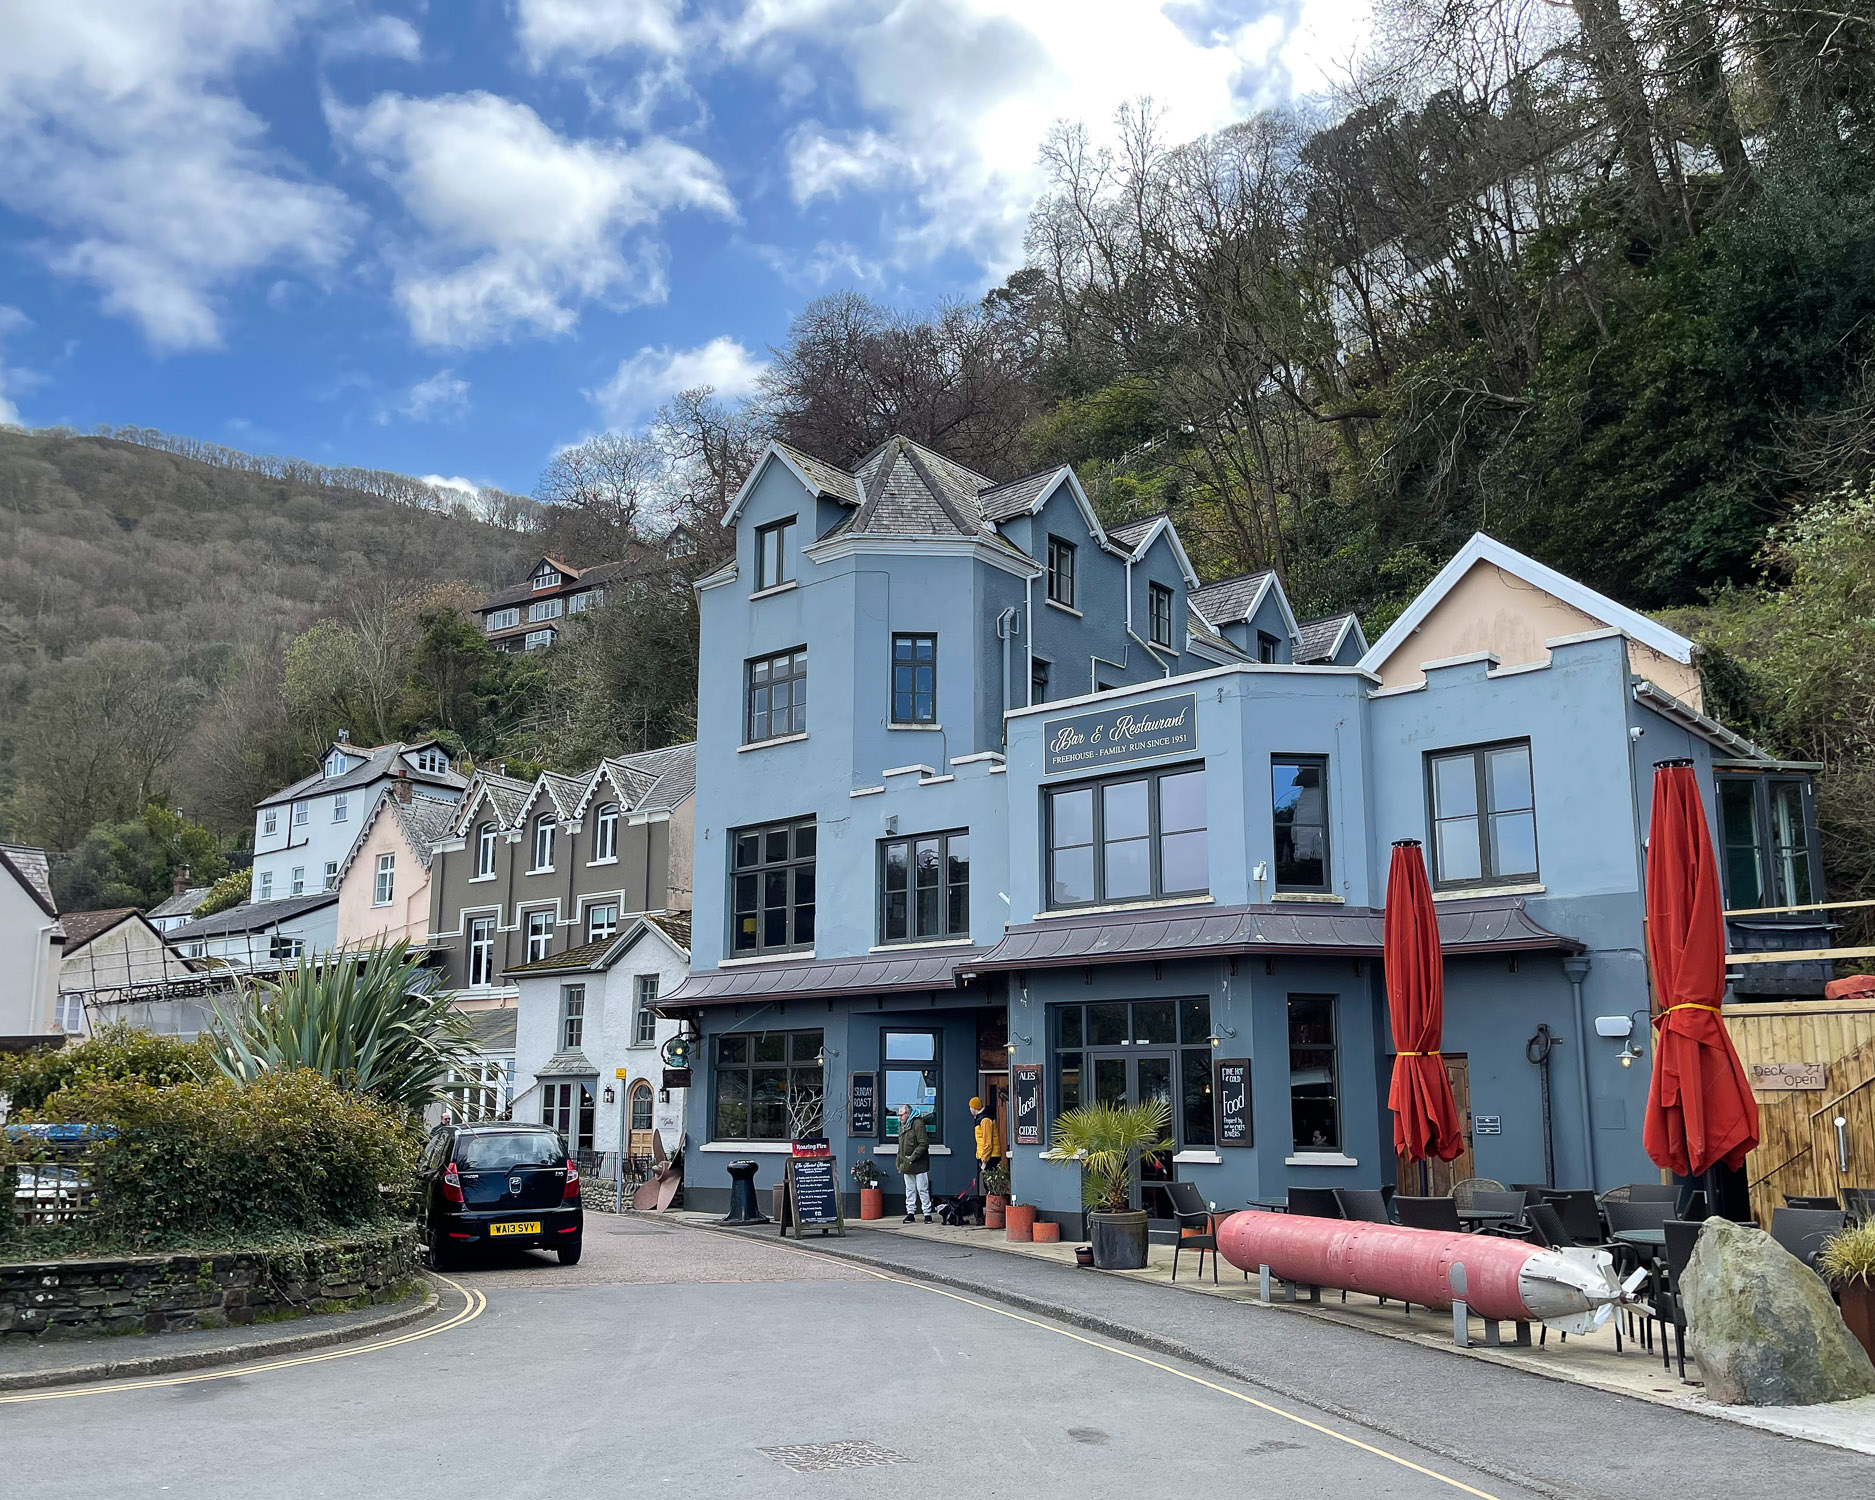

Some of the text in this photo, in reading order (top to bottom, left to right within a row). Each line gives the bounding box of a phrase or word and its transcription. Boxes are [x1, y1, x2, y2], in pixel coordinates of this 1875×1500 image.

[1050, 727, 1085, 753] Bar
[1109, 706, 1188, 742] Restaurant
[1052, 750, 1094, 764] FREEHOUSE
[1100, 745, 1127, 757] FAMILY
[1129, 741, 1146, 751] RUN
[1147, 738, 1170, 748] SINCE
[1171, 734, 1187, 743] 1951
[1234, 1067, 1244, 1075] HOT
[1753, 1063, 1787, 1077] Deck
[1229, 1075, 1241, 1083] COLD
[1784, 1075, 1817, 1088] Open
[854, 1087, 873, 1096] SUNDAY
[854, 1097, 872, 1107] ROAST
[1222, 1082, 1245, 1116] Food
[1018, 1126, 1038, 1136] CIDER
[796, 1143, 816, 1151] Roaring
[495, 1223, 535, 1234] WA13 SVY
